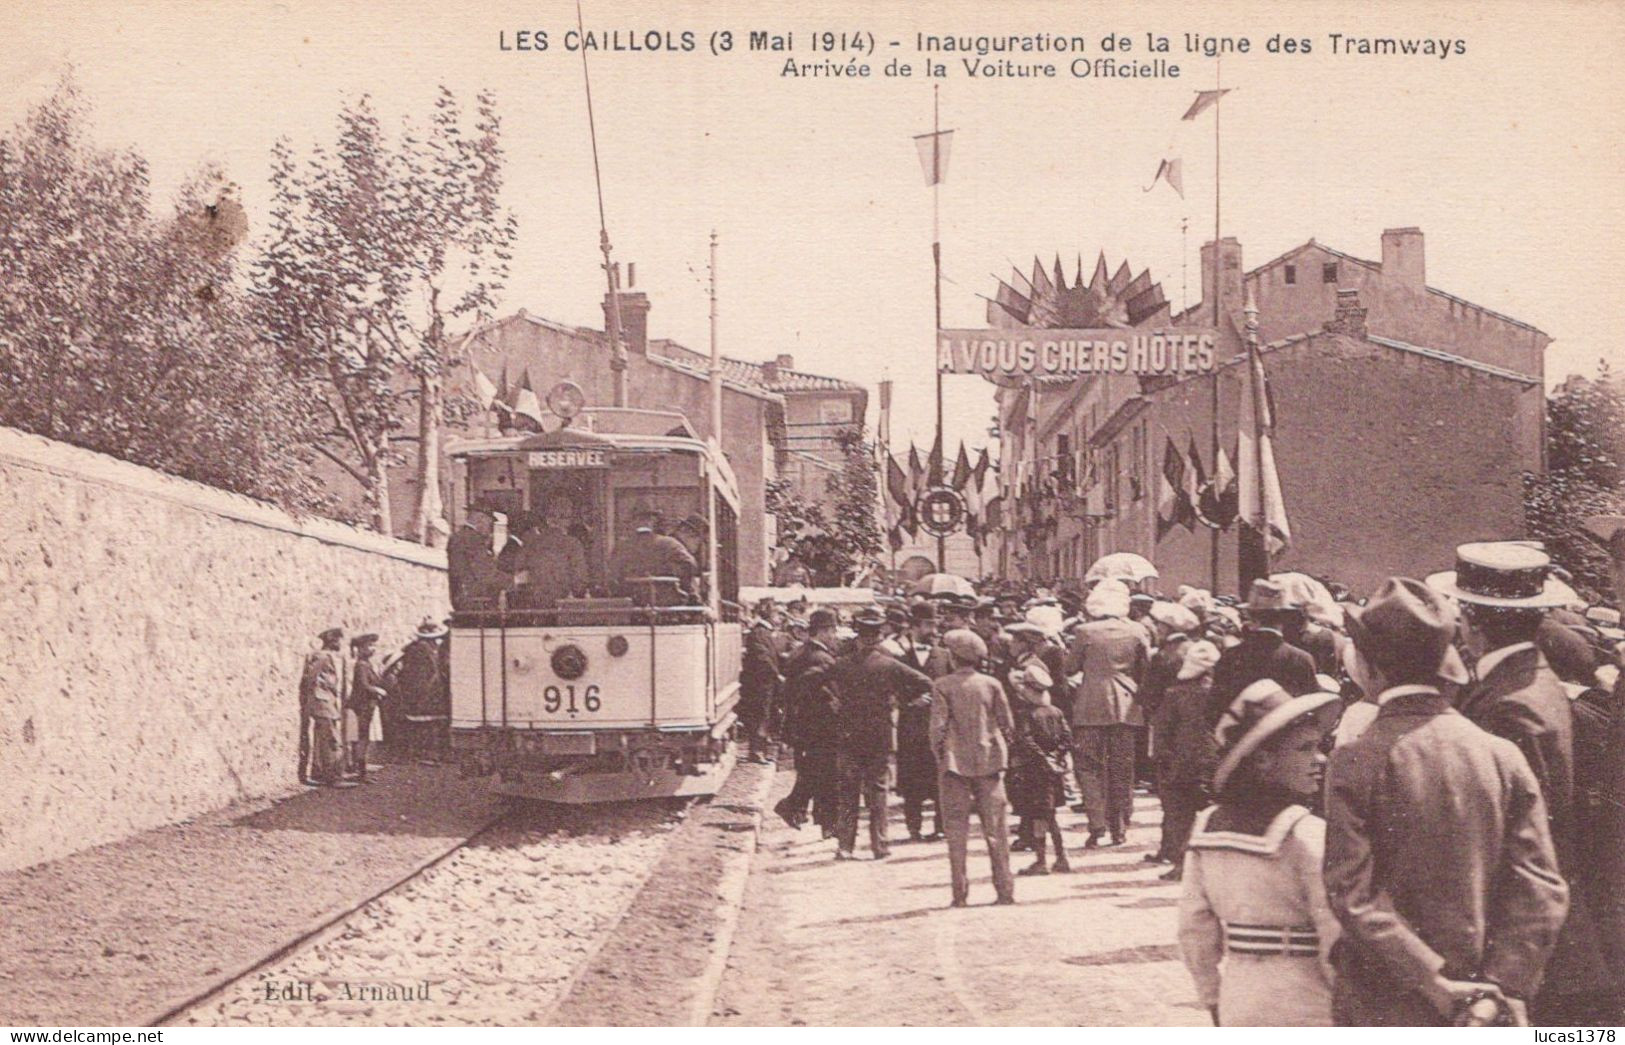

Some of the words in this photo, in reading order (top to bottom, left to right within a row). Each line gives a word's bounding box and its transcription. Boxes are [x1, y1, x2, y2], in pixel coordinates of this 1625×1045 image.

[960, 339, 1036, 373] VOUS
[1041, 339, 1128, 374] CHERS
[1131, 332, 1215, 374] HÔTES
[543, 685, 602, 714] 916
